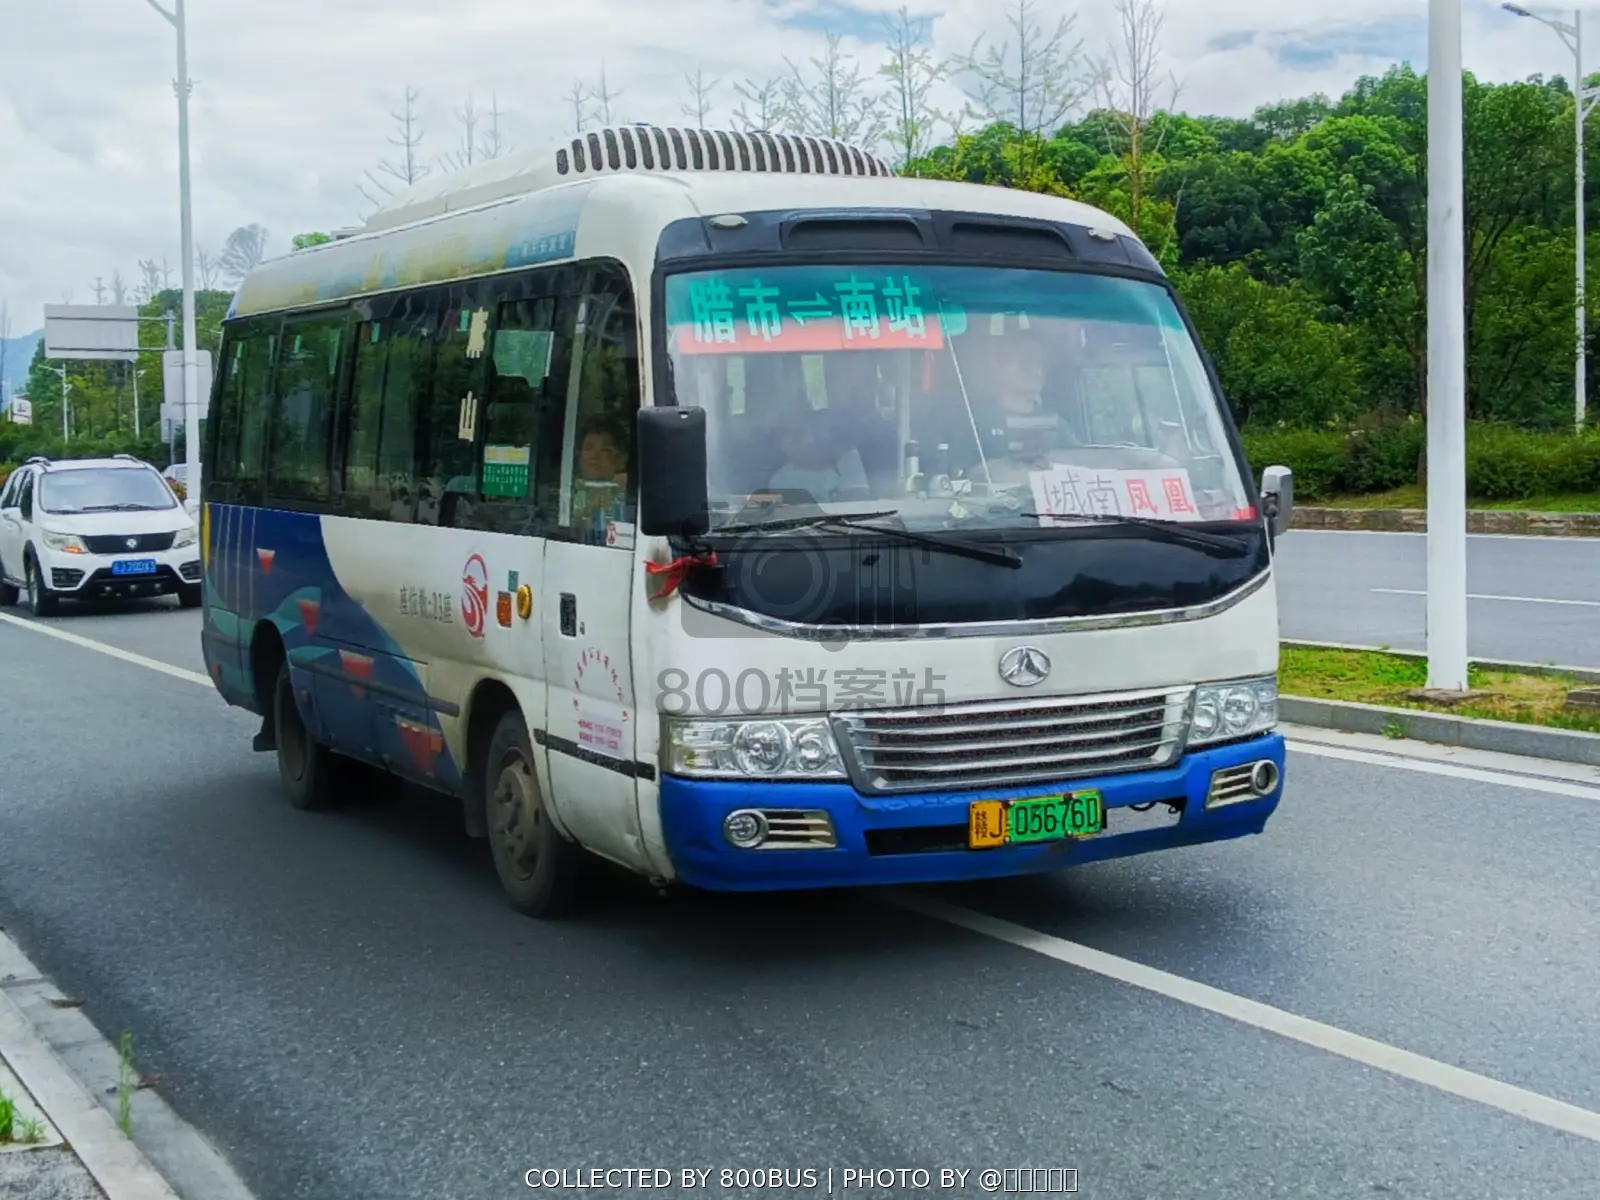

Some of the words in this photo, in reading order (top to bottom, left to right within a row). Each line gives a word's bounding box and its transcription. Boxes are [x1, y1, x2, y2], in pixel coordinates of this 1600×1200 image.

[689, 276, 782, 344] 腊市
[834, 274, 927, 340] 南站
[1050, 469, 1122, 516] 城南
[1125, 477, 1194, 515] 凤凰
